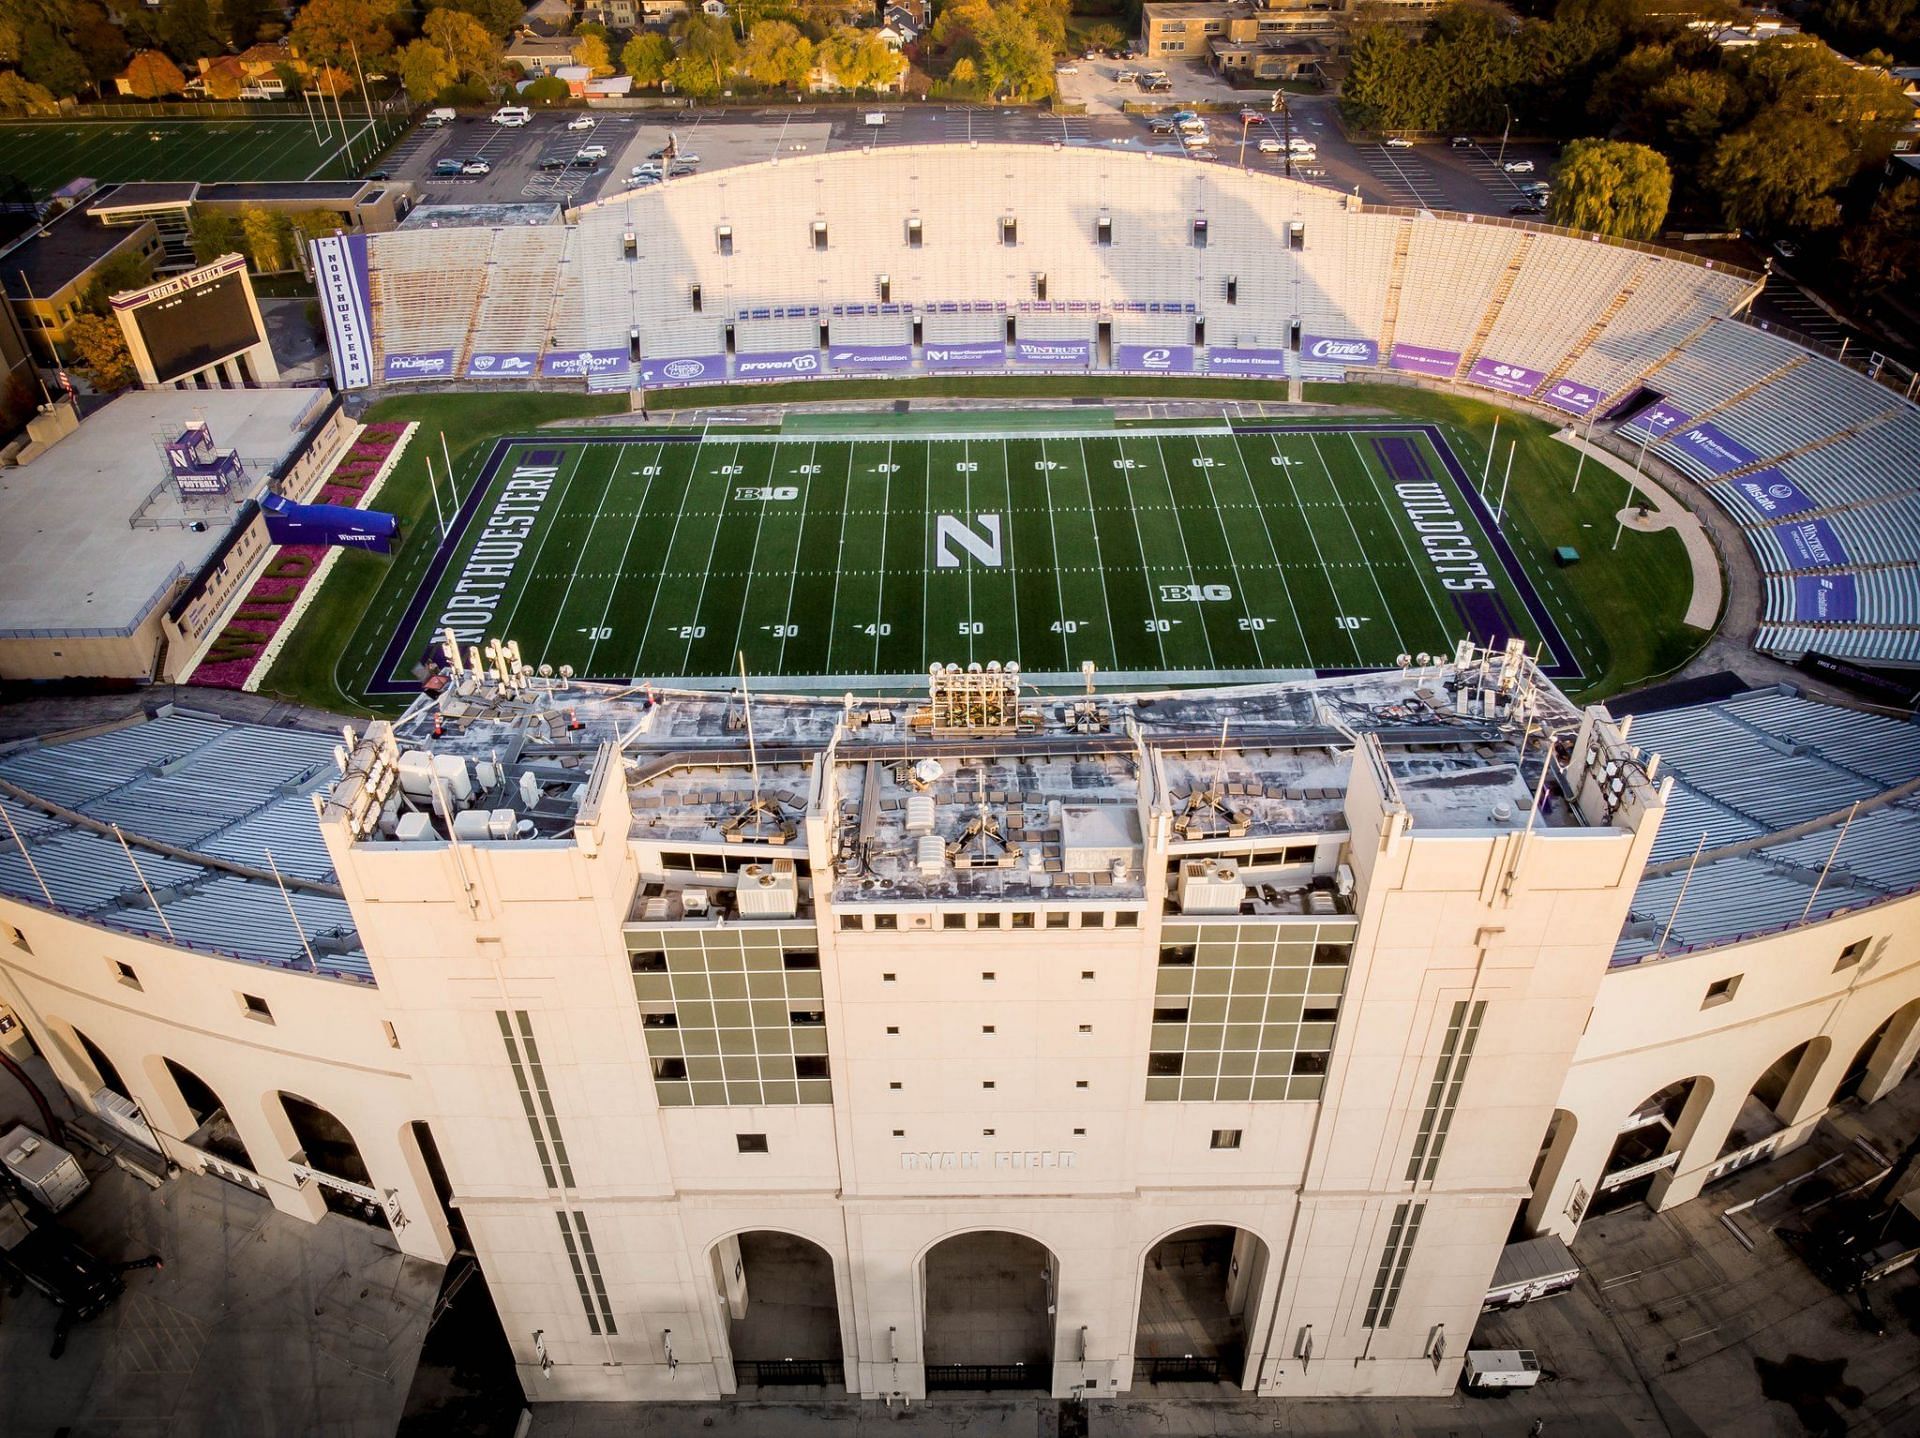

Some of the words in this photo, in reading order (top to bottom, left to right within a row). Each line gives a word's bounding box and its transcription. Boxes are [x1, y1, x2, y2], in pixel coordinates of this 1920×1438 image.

[148, 284, 174, 300] RYAN
[198, 267, 223, 281] FIELD
[328, 255, 359, 370] NORTHWESTERN
[1020, 345, 1086, 353] WINTRUST
[1312, 340, 1368, 356] Cane's
[552, 357, 620, 369] ROSEMONT
[740, 361, 792, 371] proven
[170, 450, 188, 468] N
[189, 446, 197, 462] N
[956, 463, 978, 472] 50
[1034, 461, 1057, 471] 40
[1113, 459, 1136, 469] 30
[1192, 458, 1214, 468] 20
[1270, 456, 1292, 466] 10
[643, 466, 662, 476] 10
[721, 465, 744, 475] 20
[800, 464, 822, 474] 30
[878, 464, 900, 473] 40
[1741, 483, 1776, 511] Allstate
[936, 514, 1002, 567] N
[1394, 482, 1495, 590] WILDCATS
[1802, 523, 1830, 563] WINTRUST
[430, 466, 559, 644] NORTHWESTERN
[864, 623, 892, 636] 40
[959, 622, 984, 635] 50
[1051, 620, 1077, 633] 40
[1145, 619, 1170, 632] 30
[1238, 618, 1265, 630] 20
[1335, 616, 1360, 630] 10
[589, 627, 612, 640] 10
[679, 626, 706, 639] 20
[773, 625, 798, 637] 30
[901, 1152, 980, 1170] RYAN
[994, 1151, 1077, 1169] FIELD
